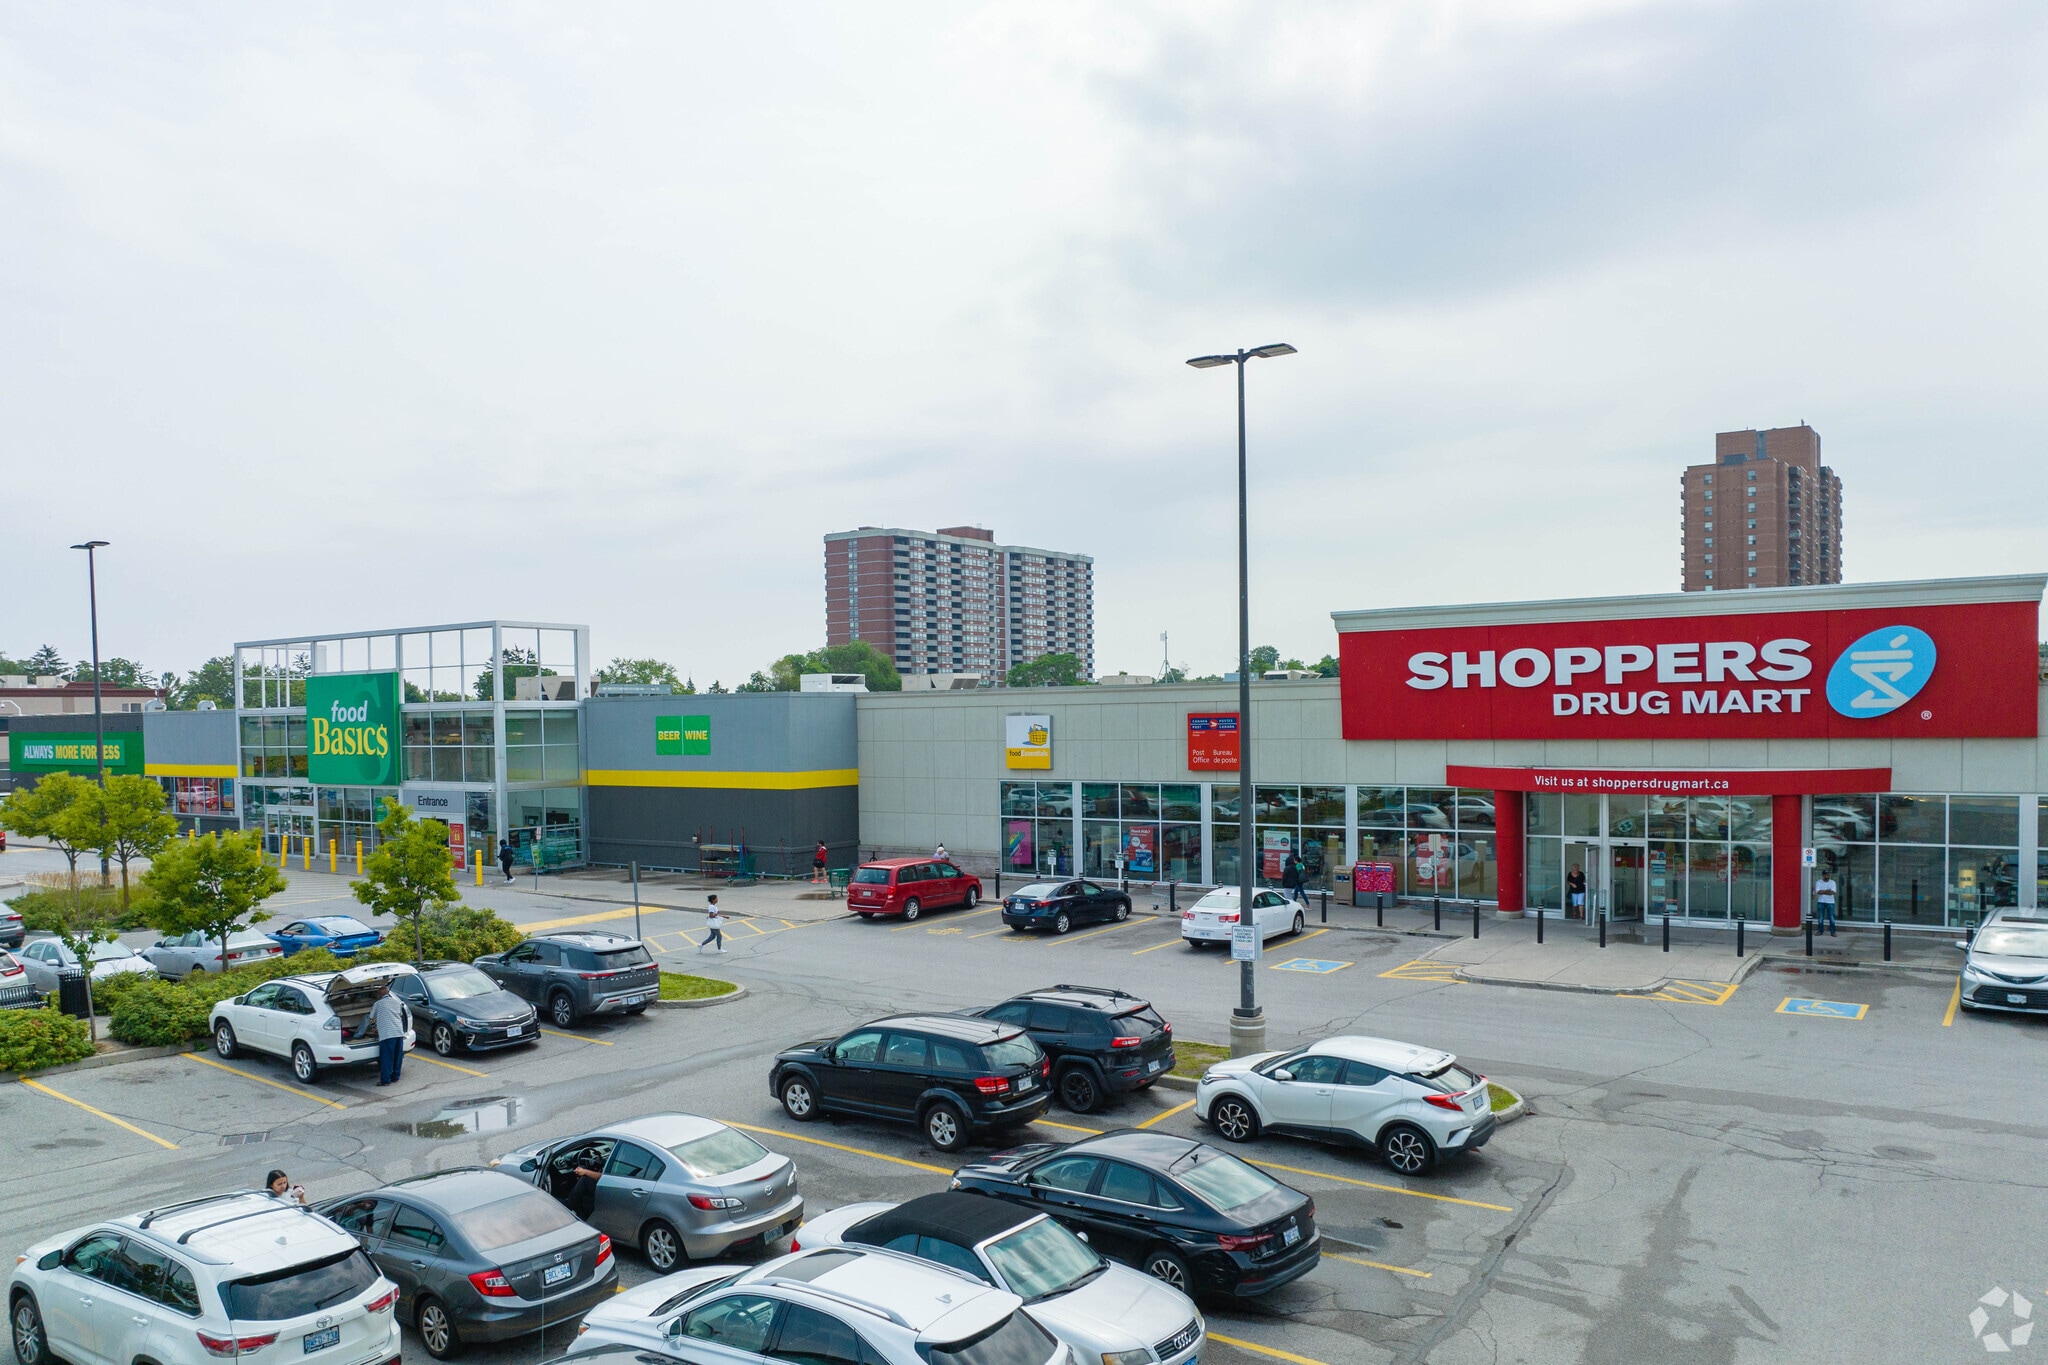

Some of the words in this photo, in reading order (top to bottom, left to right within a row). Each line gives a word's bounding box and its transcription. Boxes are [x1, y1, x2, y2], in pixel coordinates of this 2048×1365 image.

[1405, 638, 1813, 690] SHOPPERS
[1552, 690, 1670, 716] DRUG
[1682, 688, 1811, 714] MART
[331, 700, 368, 722] food
[658, 730, 680, 740] BEER
[684, 730, 708, 740] WINE
[24, 745, 54, 759] ALWAYS
[55, 745, 79, 759] MORE
[80, 745, 97, 759] FOR
[103, 745, 120, 760] ESS
[1009, 749, 1049, 757] foodEssentials
[1192, 756, 1210, 764] Office
[1213, 756, 1221, 764] de
[1221, 757, 1238, 765] poste
[1534, 775, 1558, 787] Visit
[1561, 778, 1574, 787] us
[1577, 777, 1589, 787] at
[1592, 777, 1730, 791] shoppersdrugmart.ca
[418, 795, 449, 808] Entrance
